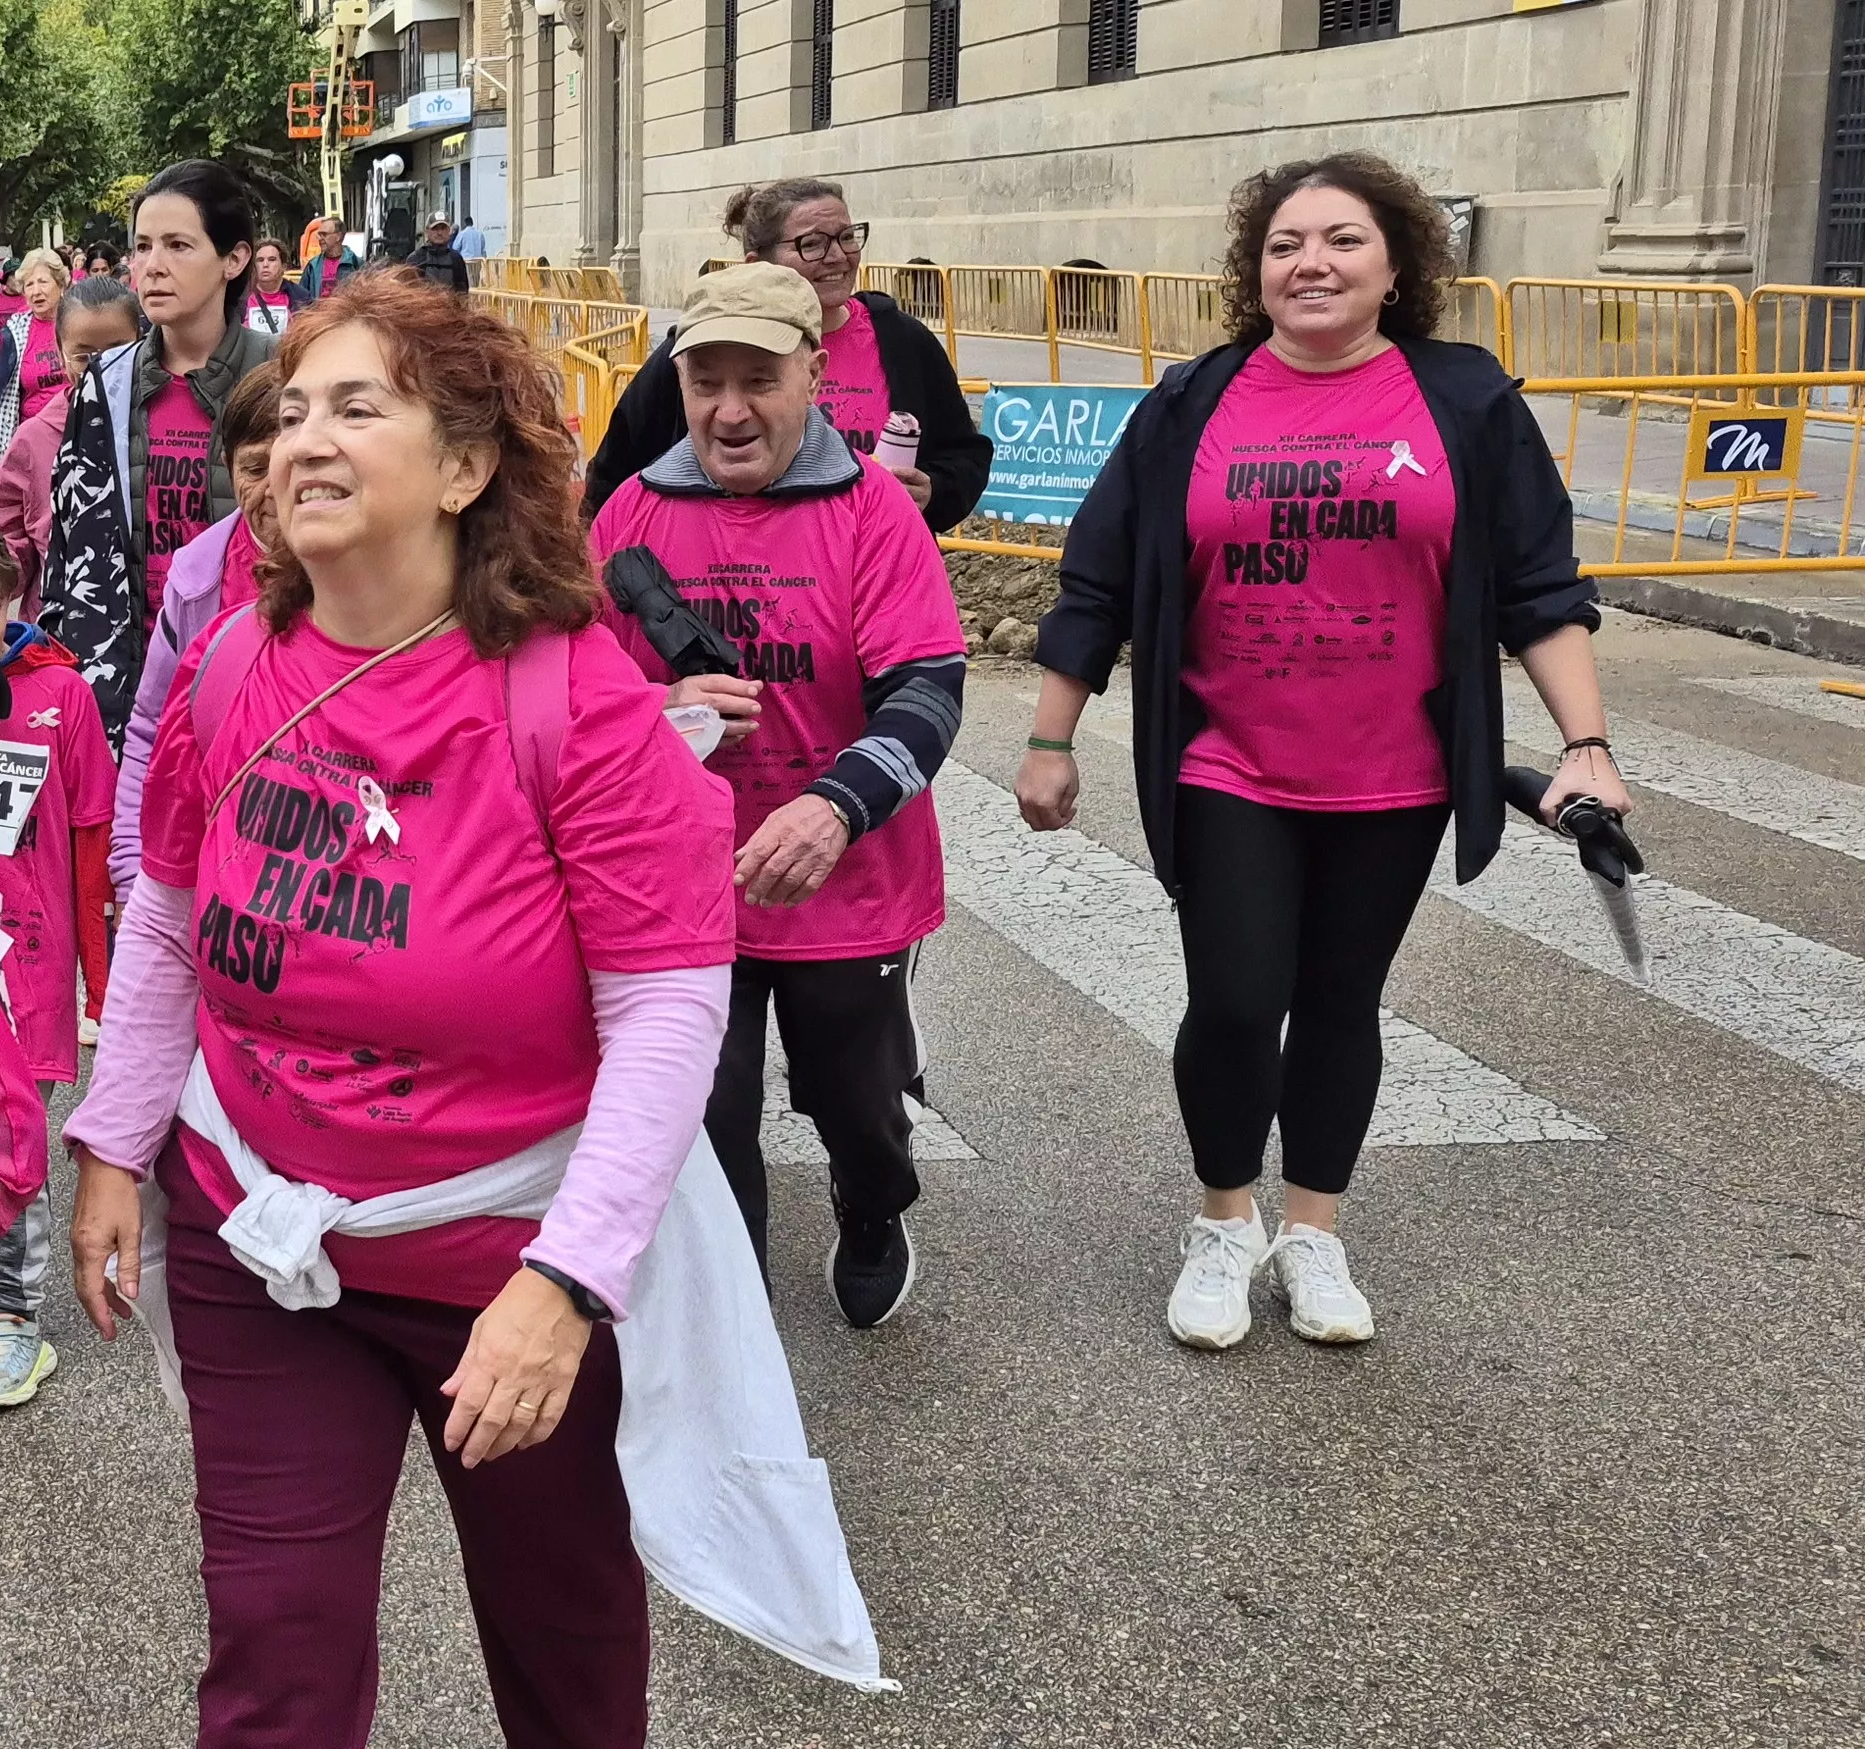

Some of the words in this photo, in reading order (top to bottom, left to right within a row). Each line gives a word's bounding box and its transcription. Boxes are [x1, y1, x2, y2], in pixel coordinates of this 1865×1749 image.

[177, 430, 211, 439] CARRER
[1336, 442, 1350, 450] EL
[1226, 460, 1343, 500] UNIDOS
[158, 490, 181, 520] EN
[1269, 500, 1310, 540] EN
[1316, 500, 1398, 540] CADA
[1222, 541, 1310, 585] PASO
[751, 577, 766, 587] EL
[769, 576, 816, 588] CÁNCER
[0, 762, 43, 778] CÁNCER
[245, 853, 308, 922] EN
[300, 867, 411, 950] CADA
[197, 892, 285, 994] PASO
